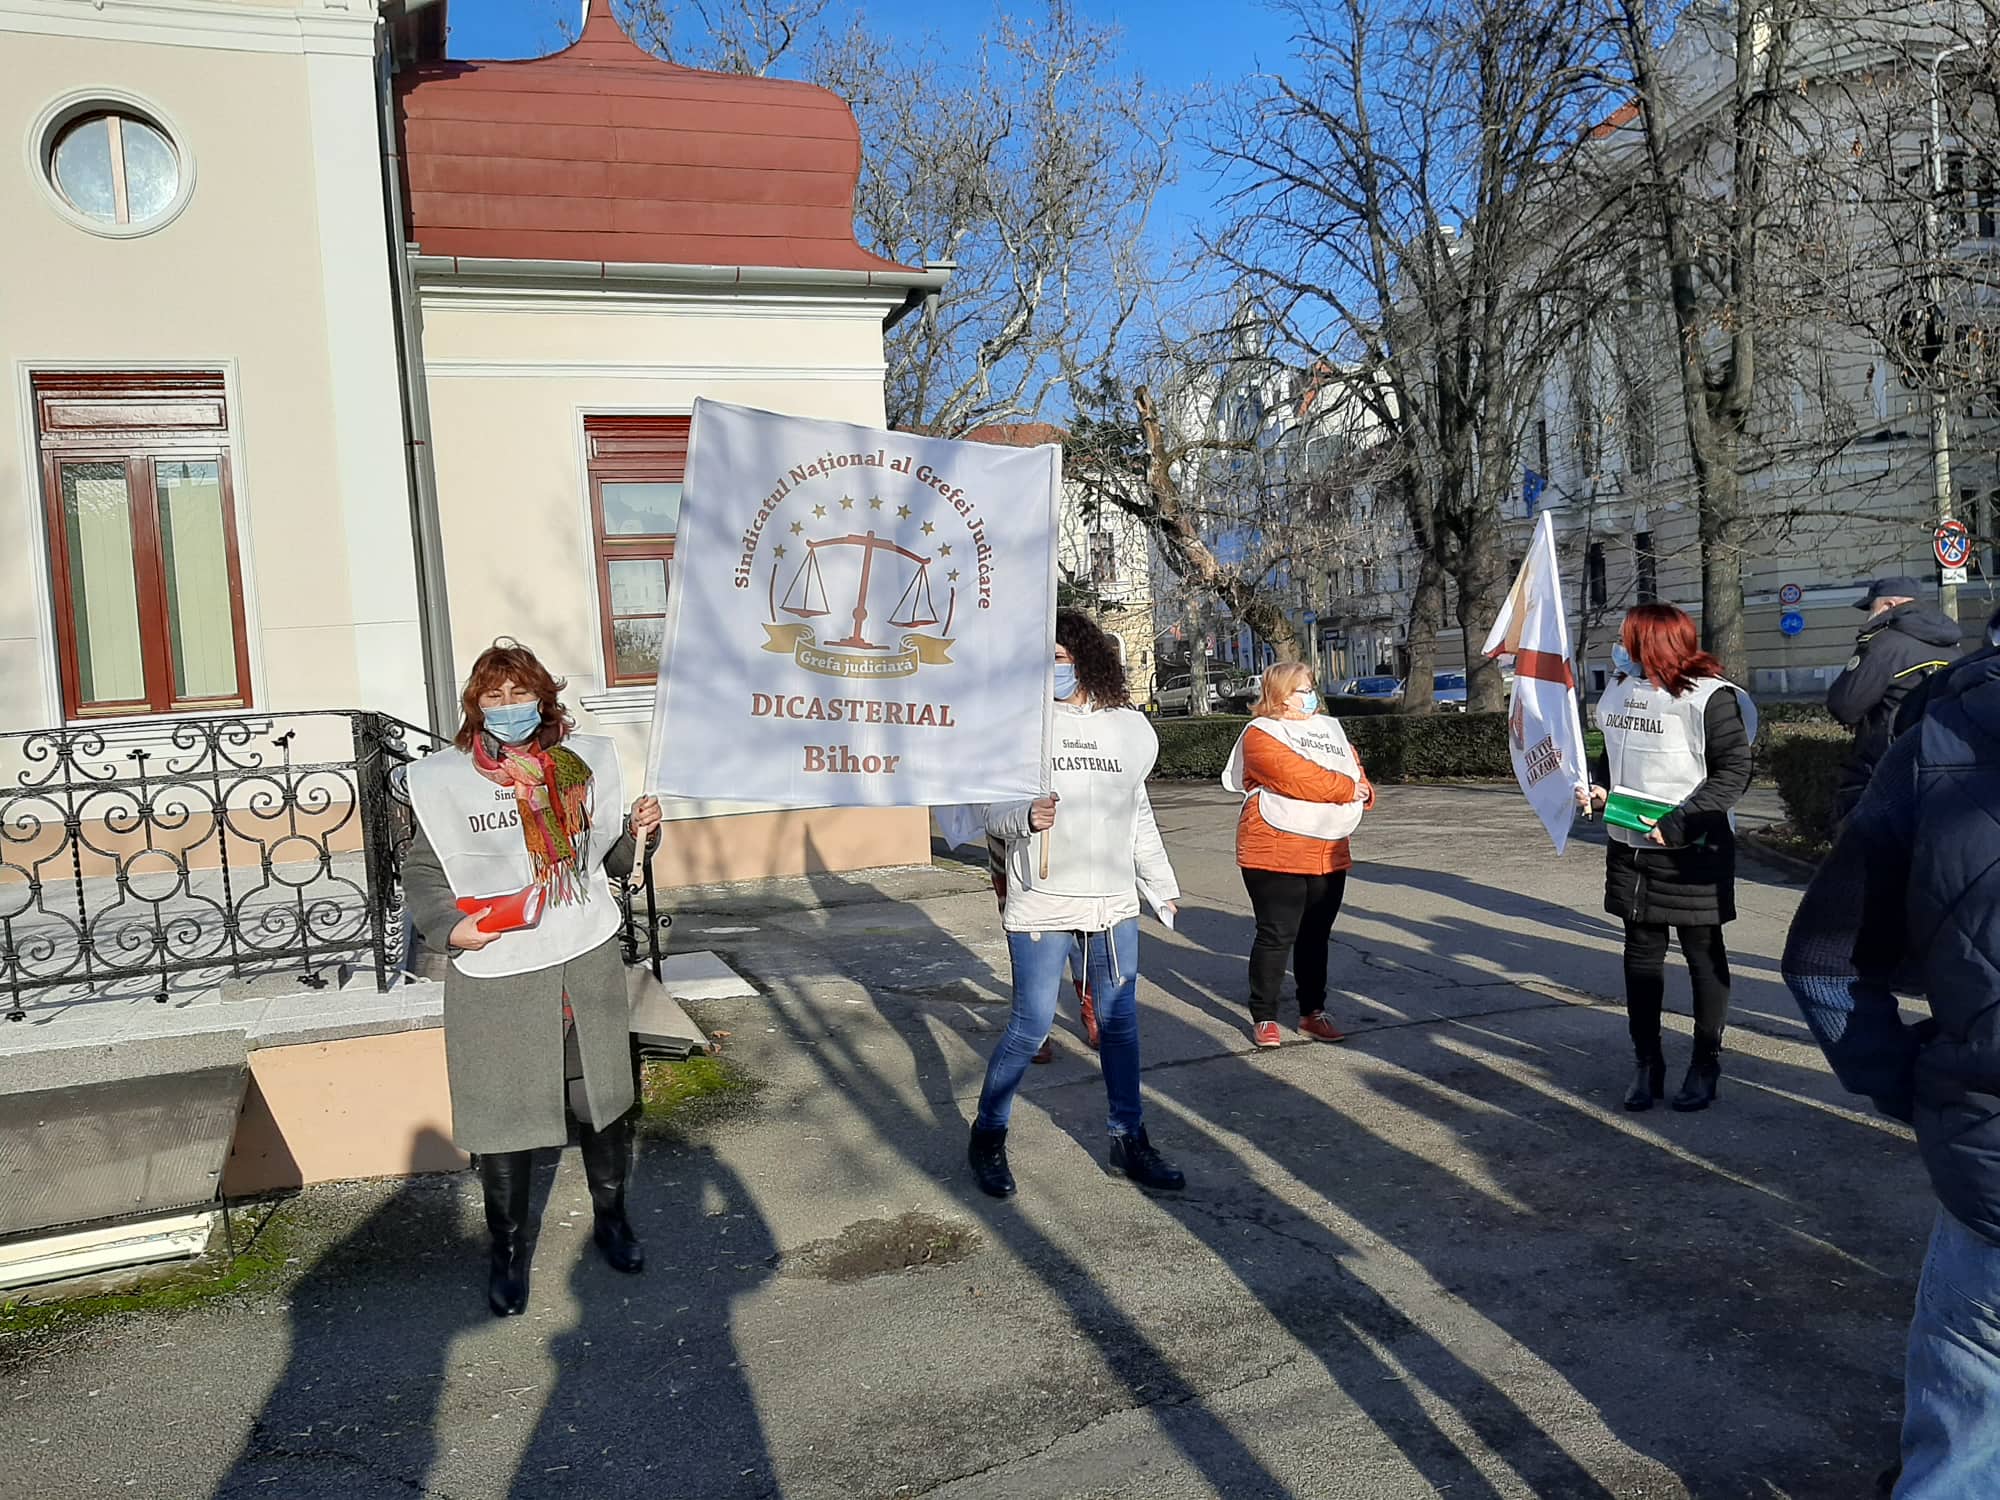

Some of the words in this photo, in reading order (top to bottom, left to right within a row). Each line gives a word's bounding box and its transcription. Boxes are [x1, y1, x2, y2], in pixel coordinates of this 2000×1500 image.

[734, 477, 791, 589] Sindicatul
[889, 456, 912, 474] al
[915, 465, 974, 517] Grefei
[800, 650, 840, 671] Grefa
[751, 692, 955, 727] DICASTERIAL
[1605, 713, 1664, 734] DICASTERIAL
[803, 745, 900, 774] Bihor
[1051, 756, 1122, 772] ICASTERIAL
